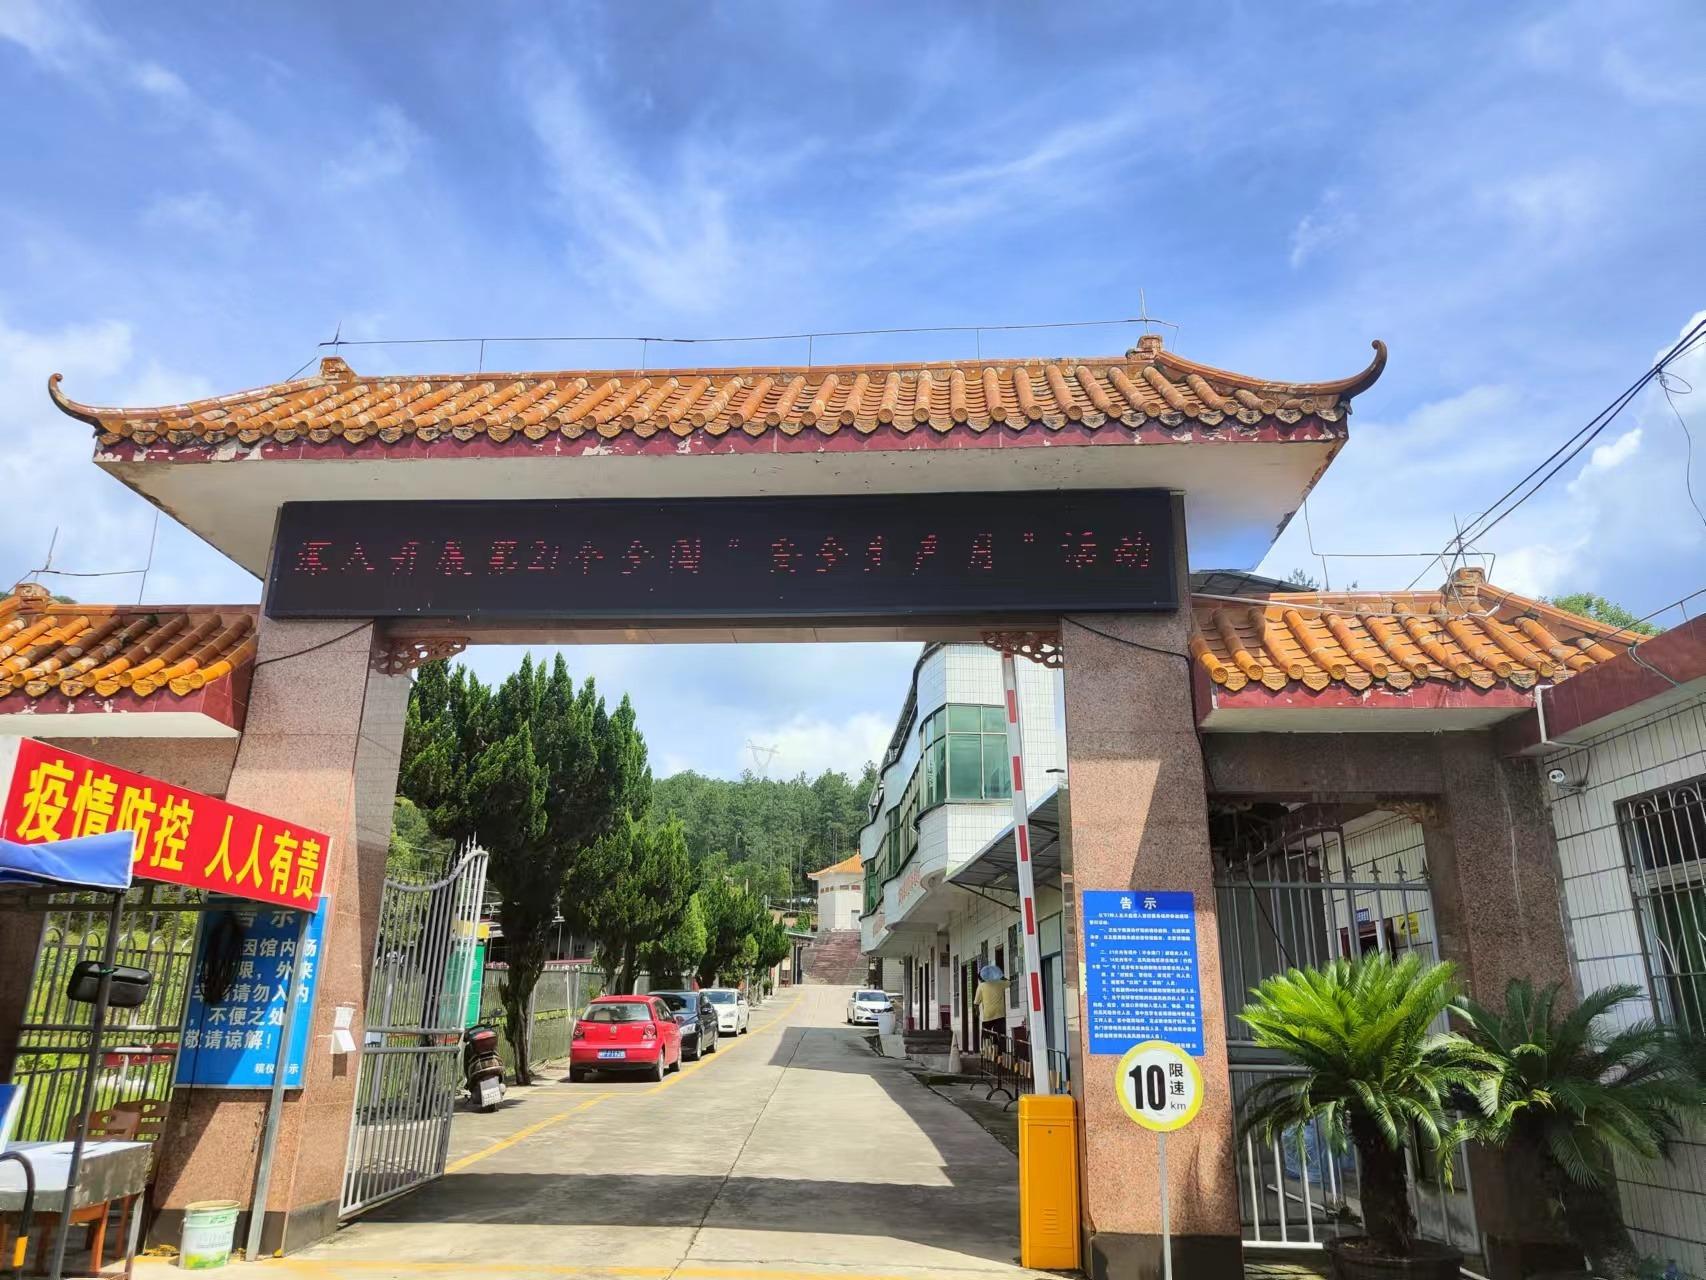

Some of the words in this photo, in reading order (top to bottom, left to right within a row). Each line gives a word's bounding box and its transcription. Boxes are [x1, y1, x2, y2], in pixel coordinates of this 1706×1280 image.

[16, 759, 194, 871] 疫情防控
[204, 815, 321, 901] 人人有责
[1120, 896, 1157, 911] 告示
[1128, 1064, 1167, 1111] 10
[1169, 1063, 1185, 1096] 限速
[1170, 1101, 1187, 1111] km
